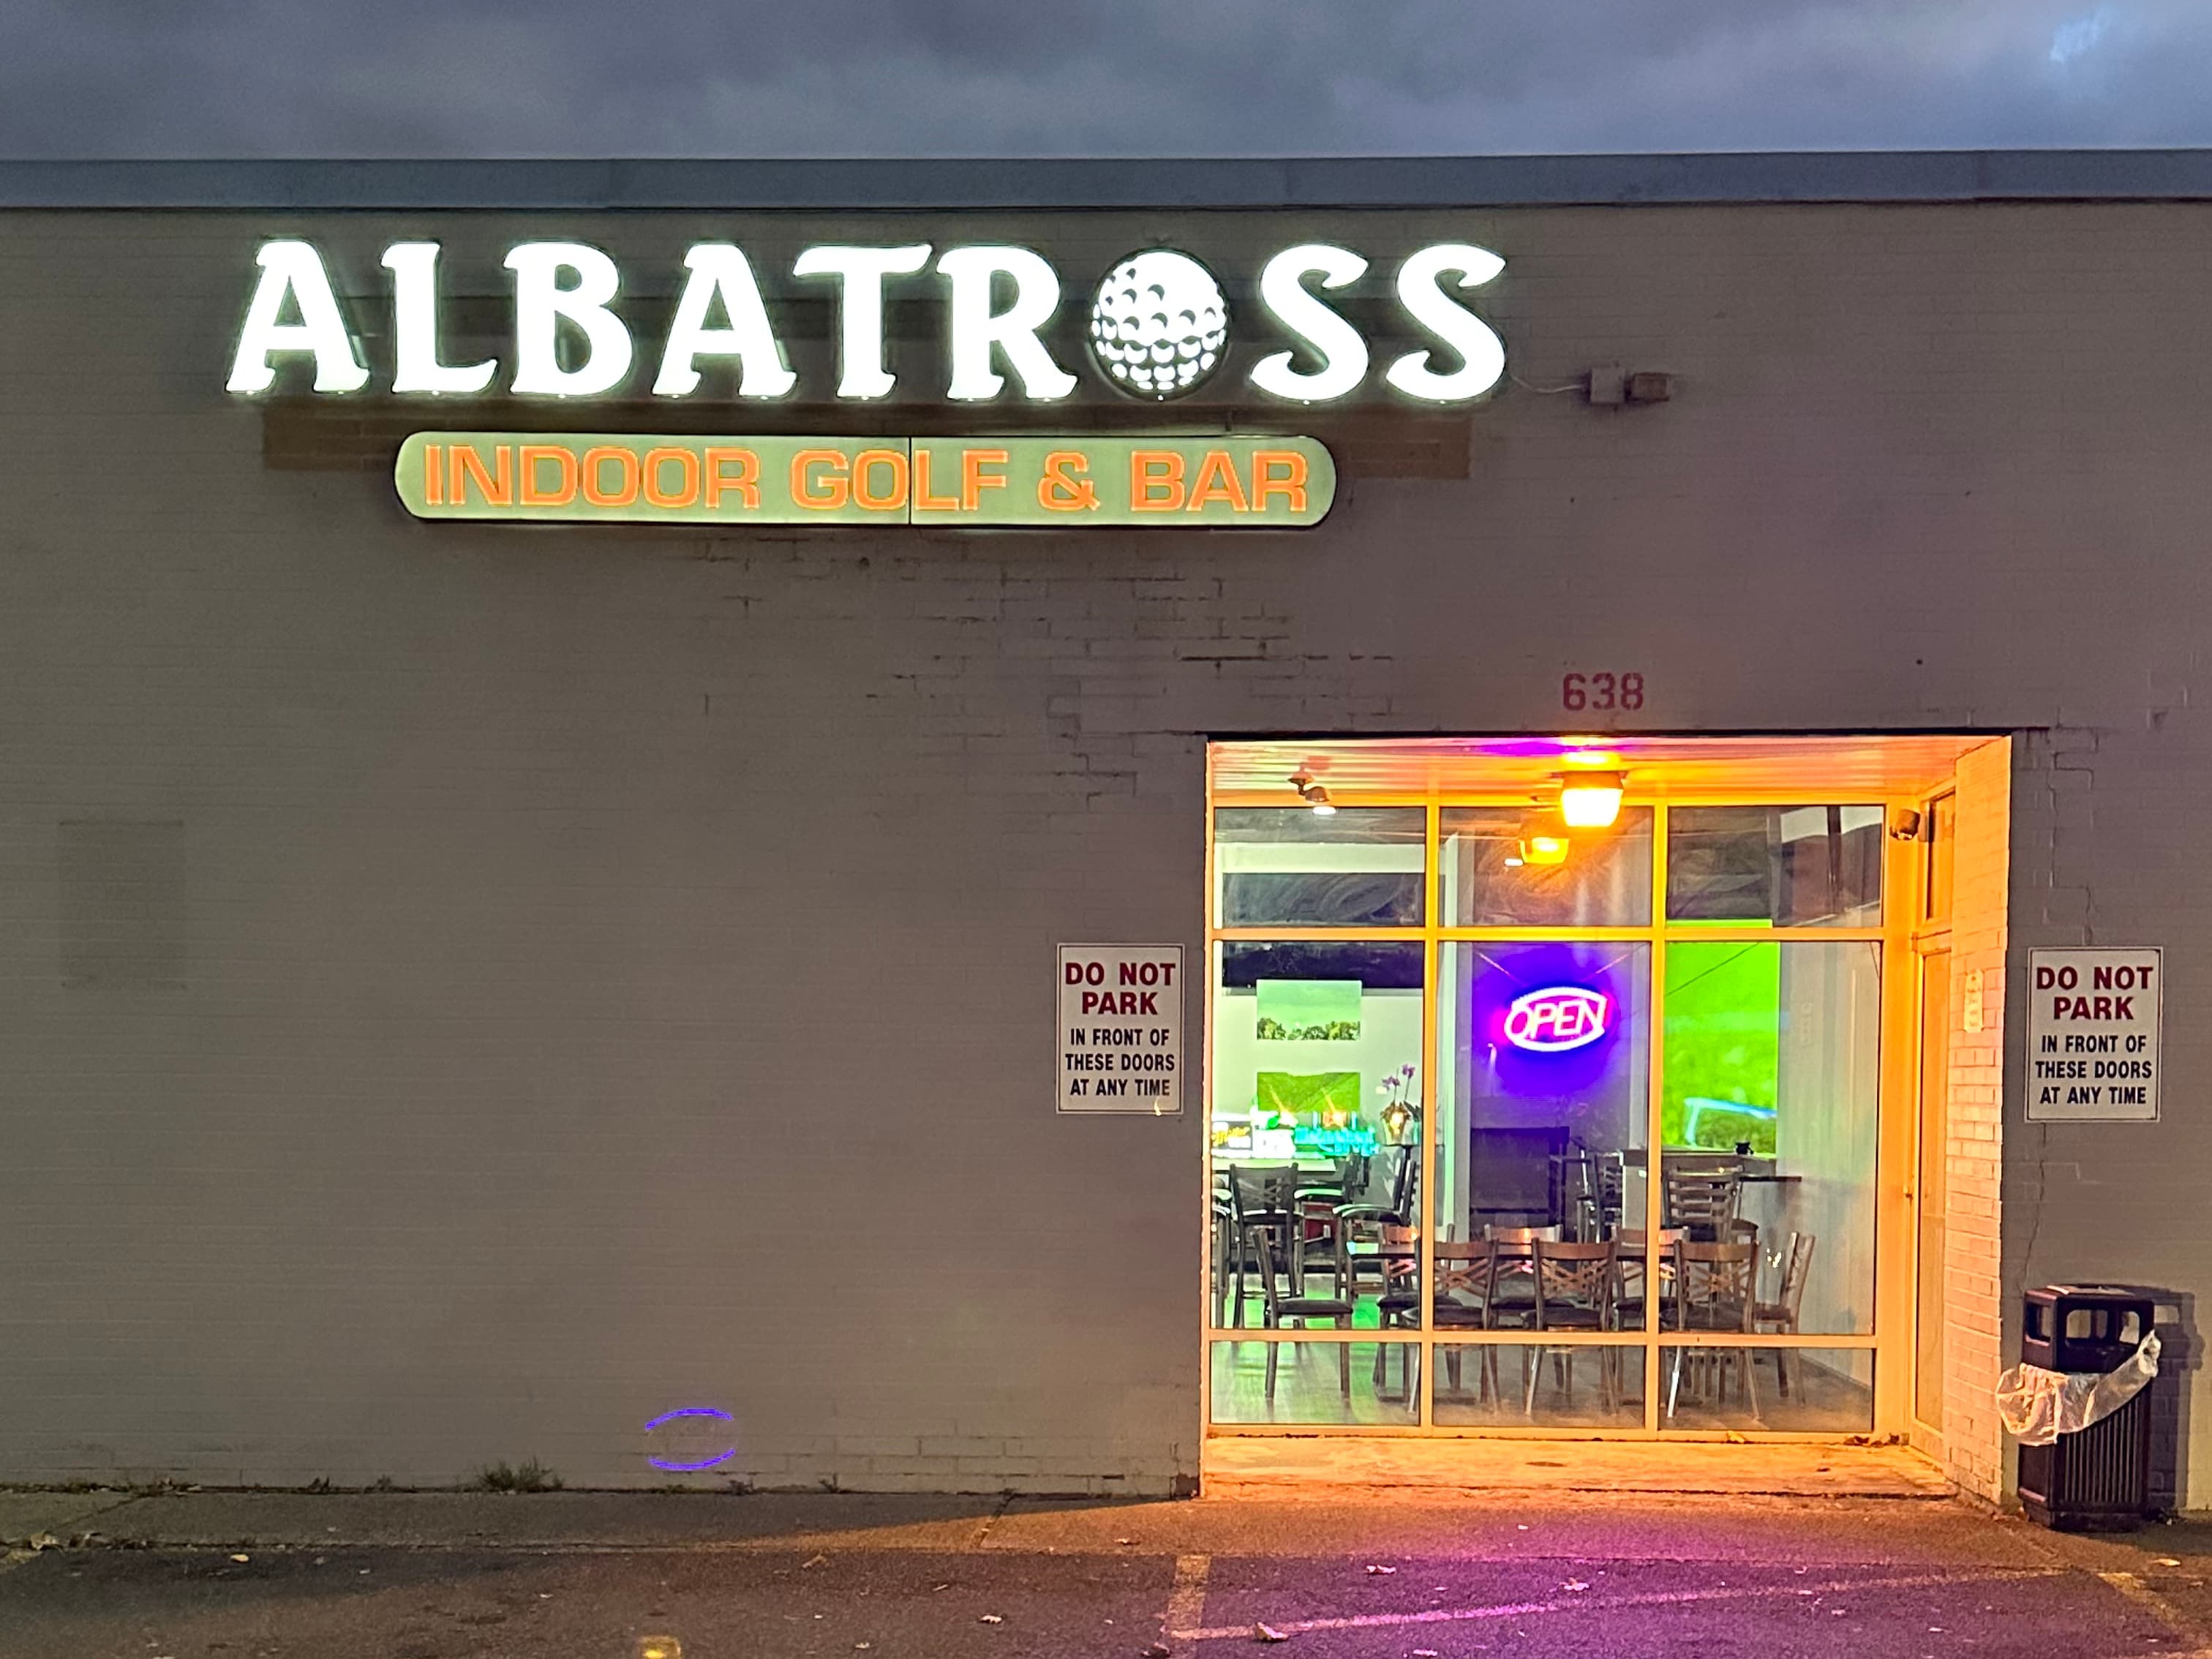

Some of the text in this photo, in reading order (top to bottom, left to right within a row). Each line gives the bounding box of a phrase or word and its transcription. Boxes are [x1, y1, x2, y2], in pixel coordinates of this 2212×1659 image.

[225, 239, 1507, 401] ALBATROSS
[425, 444, 1308, 512] INDOOR GOLF & BAR
[1563, 672, 1644, 710] 638
[1065, 962, 1176, 986] DO NOT
[2036, 966, 2153, 990] DO NOT
[1082, 991, 1158, 1015] PARK
[2053, 996, 2134, 1020] PARK
[1504, 998, 1607, 1039] OPEN
[1070, 1028, 1170, 1046] IN FRONT OF
[2042, 1034, 2147, 1053] IN FRONT OF
[1065, 1053, 1175, 1071] THESE DOORS
[2035, 1061, 2153, 1079] THESE DOORS
[1069, 1078, 1170, 1096] AT ANY TIME
[2039, 1086, 2147, 1105] AT ANY TIME
